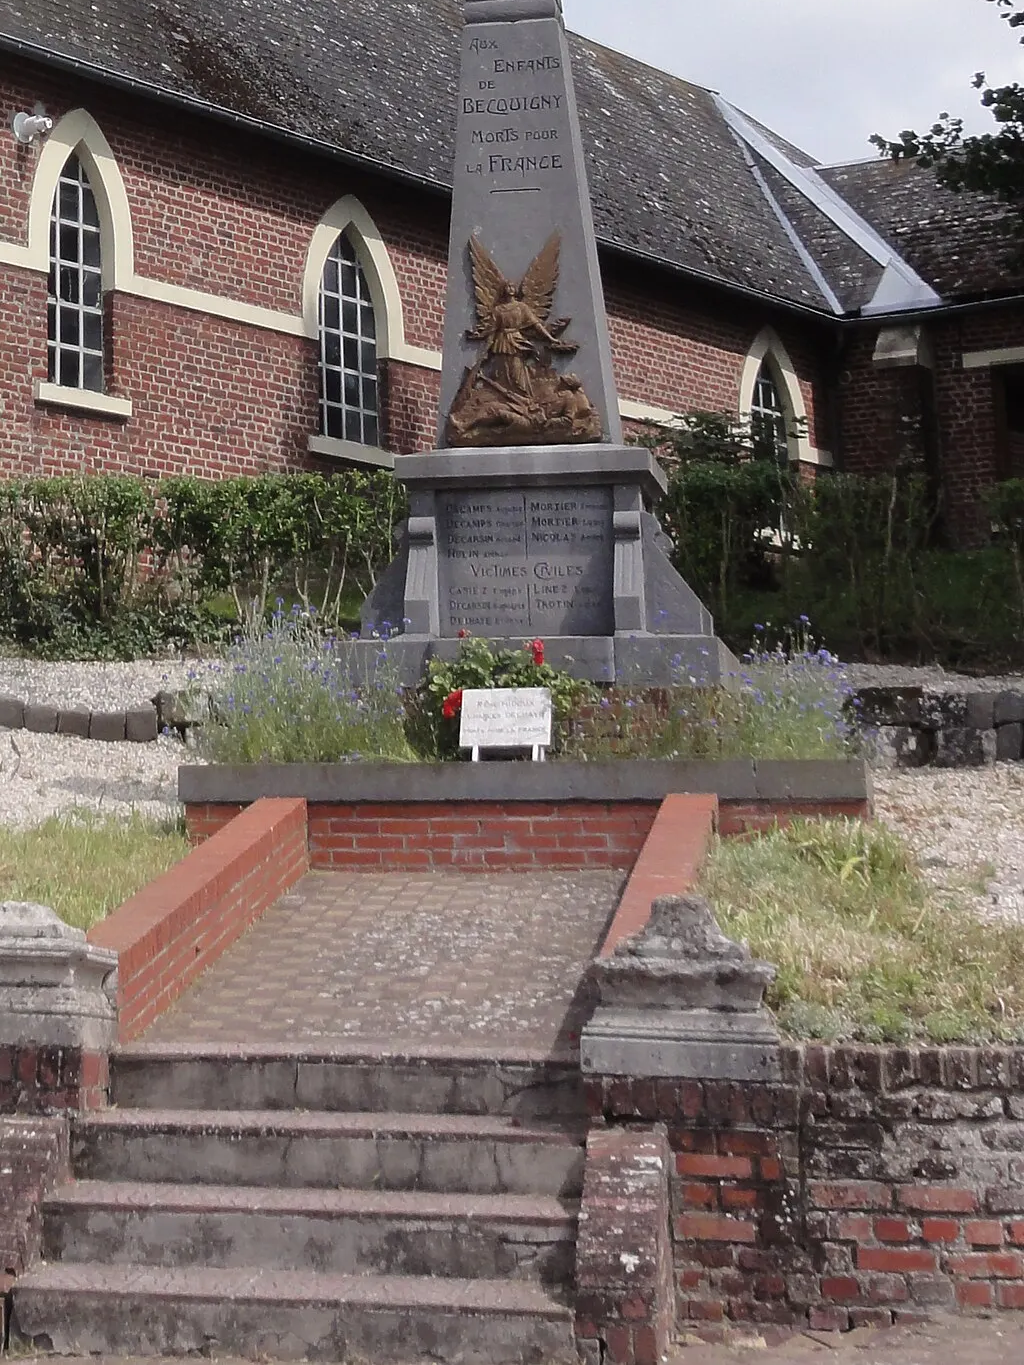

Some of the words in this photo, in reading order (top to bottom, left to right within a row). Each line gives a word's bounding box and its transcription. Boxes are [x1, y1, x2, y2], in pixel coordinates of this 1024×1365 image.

[494, 57, 561, 74] ENFANTS
[478, 80, 496, 90] DE
[463, 95, 563, 115] BECQUIGNY
[471, 128, 519, 144] MORTS
[525, 129, 558, 141] POUR
[466, 163, 482, 176] LA
[488, 155, 563, 178] FRANCE
[531, 502, 577, 511] MORTIER
[531, 516, 578, 527] MORTIER
[470, 564, 527, 578] VICTIMES
[533, 562, 584, 581] CIVILES
